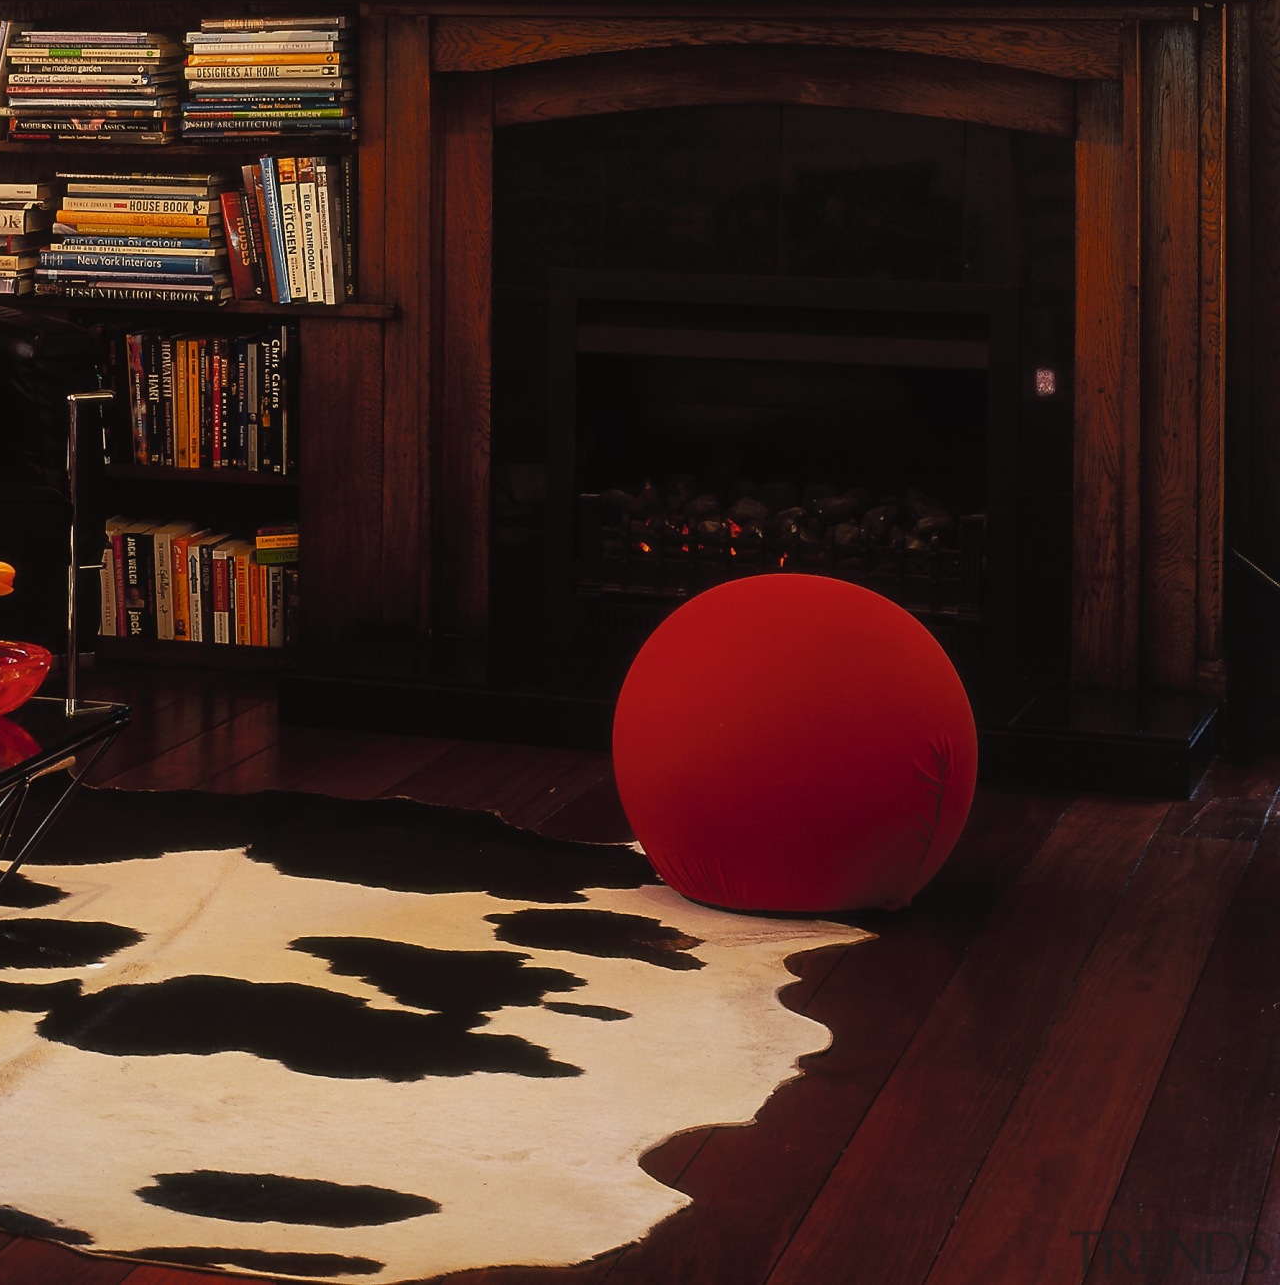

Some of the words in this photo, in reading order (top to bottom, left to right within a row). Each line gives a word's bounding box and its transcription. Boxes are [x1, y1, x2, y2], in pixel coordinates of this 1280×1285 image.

[52, 65, 77, 73] modern
[78, 66, 102, 74] garden
[196, 66, 241, 79] DESIGNERS
[243, 66, 253, 78] AT
[256, 66, 280, 78] HOME
[13, 75, 51, 84] Courtyard
[258, 102, 273, 110] New
[274, 102, 302, 110] Moderns
[21, 122, 52, 130] MODERN
[53, 122, 96, 131] FURNITURE
[96, 122, 126, 131] CLASSICS
[184, 121, 215, 130] INSIDE
[216, 120, 283, 130] ARCHITECTURE
[67, 201, 89, 209] TERENCE
[129, 200, 161, 213] HOUSE
[162, 201, 190, 214] BOOK
[303, 193, 312, 212] BED
[304, 212, 311, 221] &
[319, 191, 328, 232] HARMONIOUS
[133, 215, 156, 225] small
[157, 217, 188, 227] spaces
[283, 203, 297, 255] KITCHEN
[97, 239, 124, 247] GUILD
[127, 240, 142, 248] ON
[145, 241, 182, 249] COLOUR
[252, 223, 263, 254] DESIGN
[304, 221, 316, 271] BATHROOM
[77, 256, 99, 266] New
[100, 256, 120, 266] York
[122, 257, 162, 268] Interiors
[271, 338, 281, 369] Chris
[160, 342, 172, 398] HOWARTH
[147, 373, 159, 402] HART
[271, 373, 281, 410] Cairns
[126, 536, 137, 557] JACK
[127, 558, 138, 585] WELCH
[271, 571, 281, 581] The
[127, 610, 142, 635] jack
